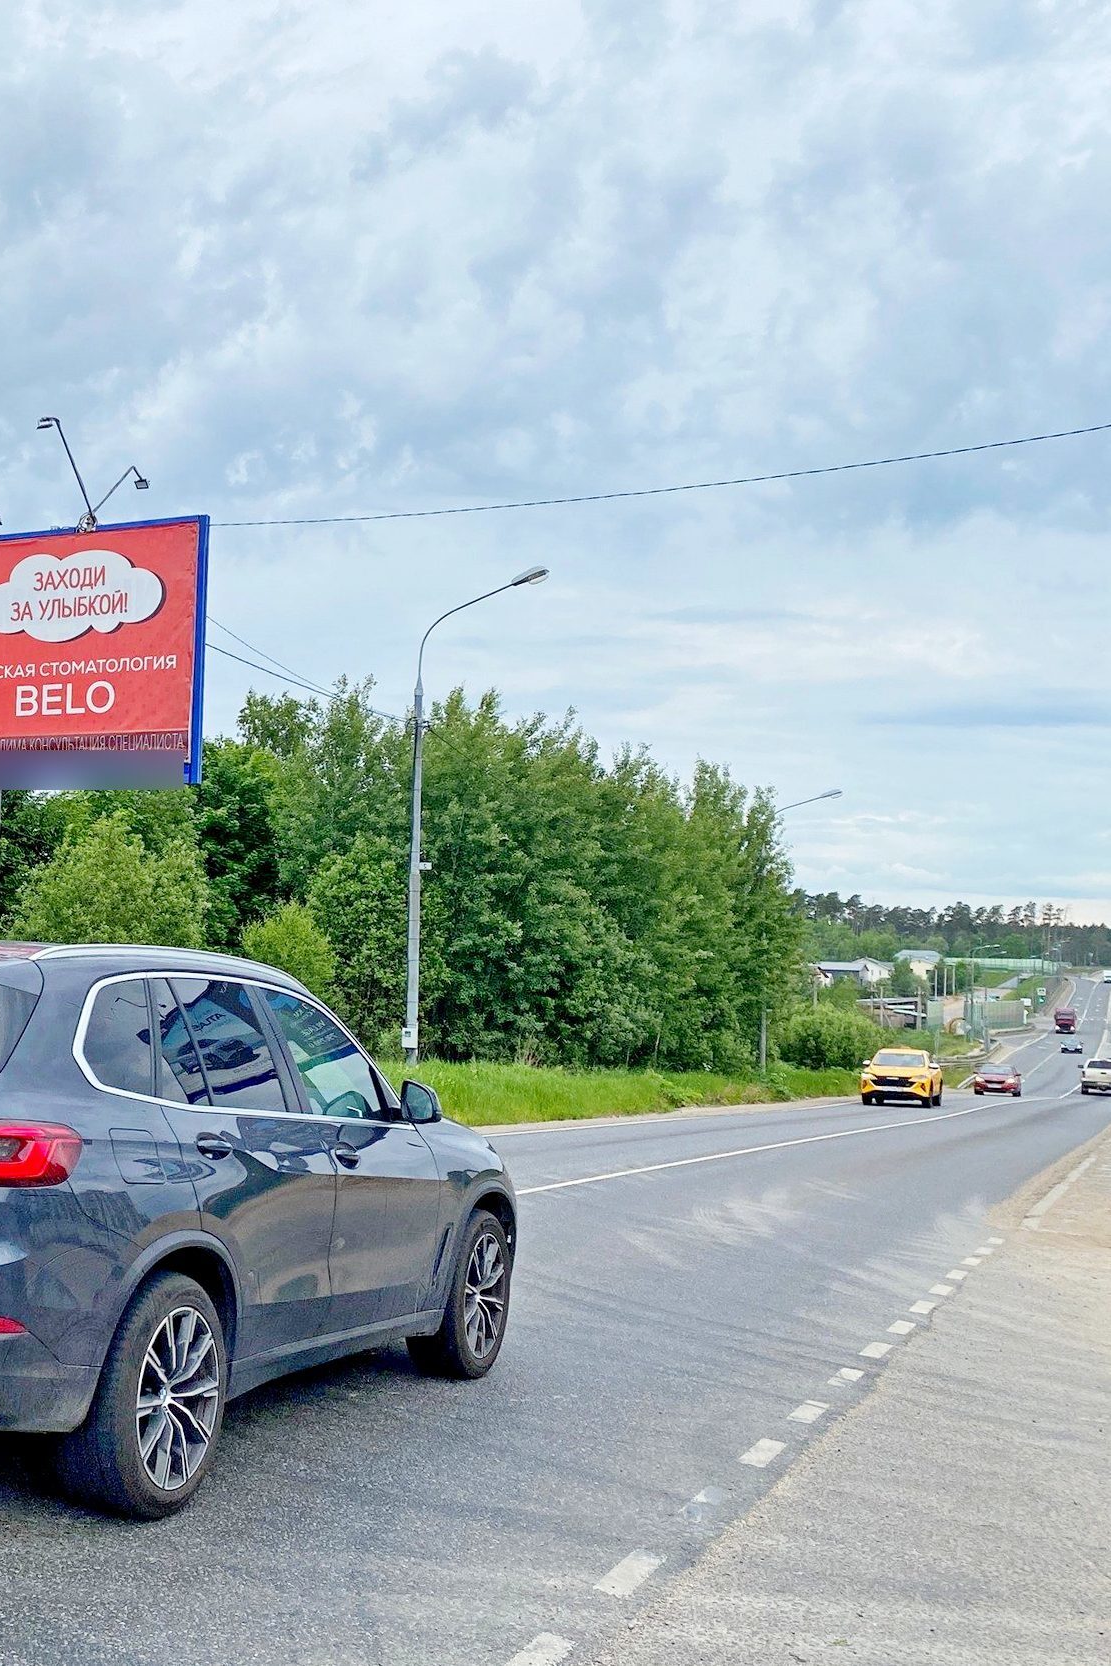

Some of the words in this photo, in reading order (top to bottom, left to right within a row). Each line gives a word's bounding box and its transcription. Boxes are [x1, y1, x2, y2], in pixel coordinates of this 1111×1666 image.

[33, 565, 106, 591] ЗАХОДИ
[10, 601, 33, 622] ЗА
[38, 589, 128, 621] УЛЫБКОЙ!
[39, 654, 177, 677] СТОМАТОЛОГИЯ
[15, 680, 116, 717] BELO
